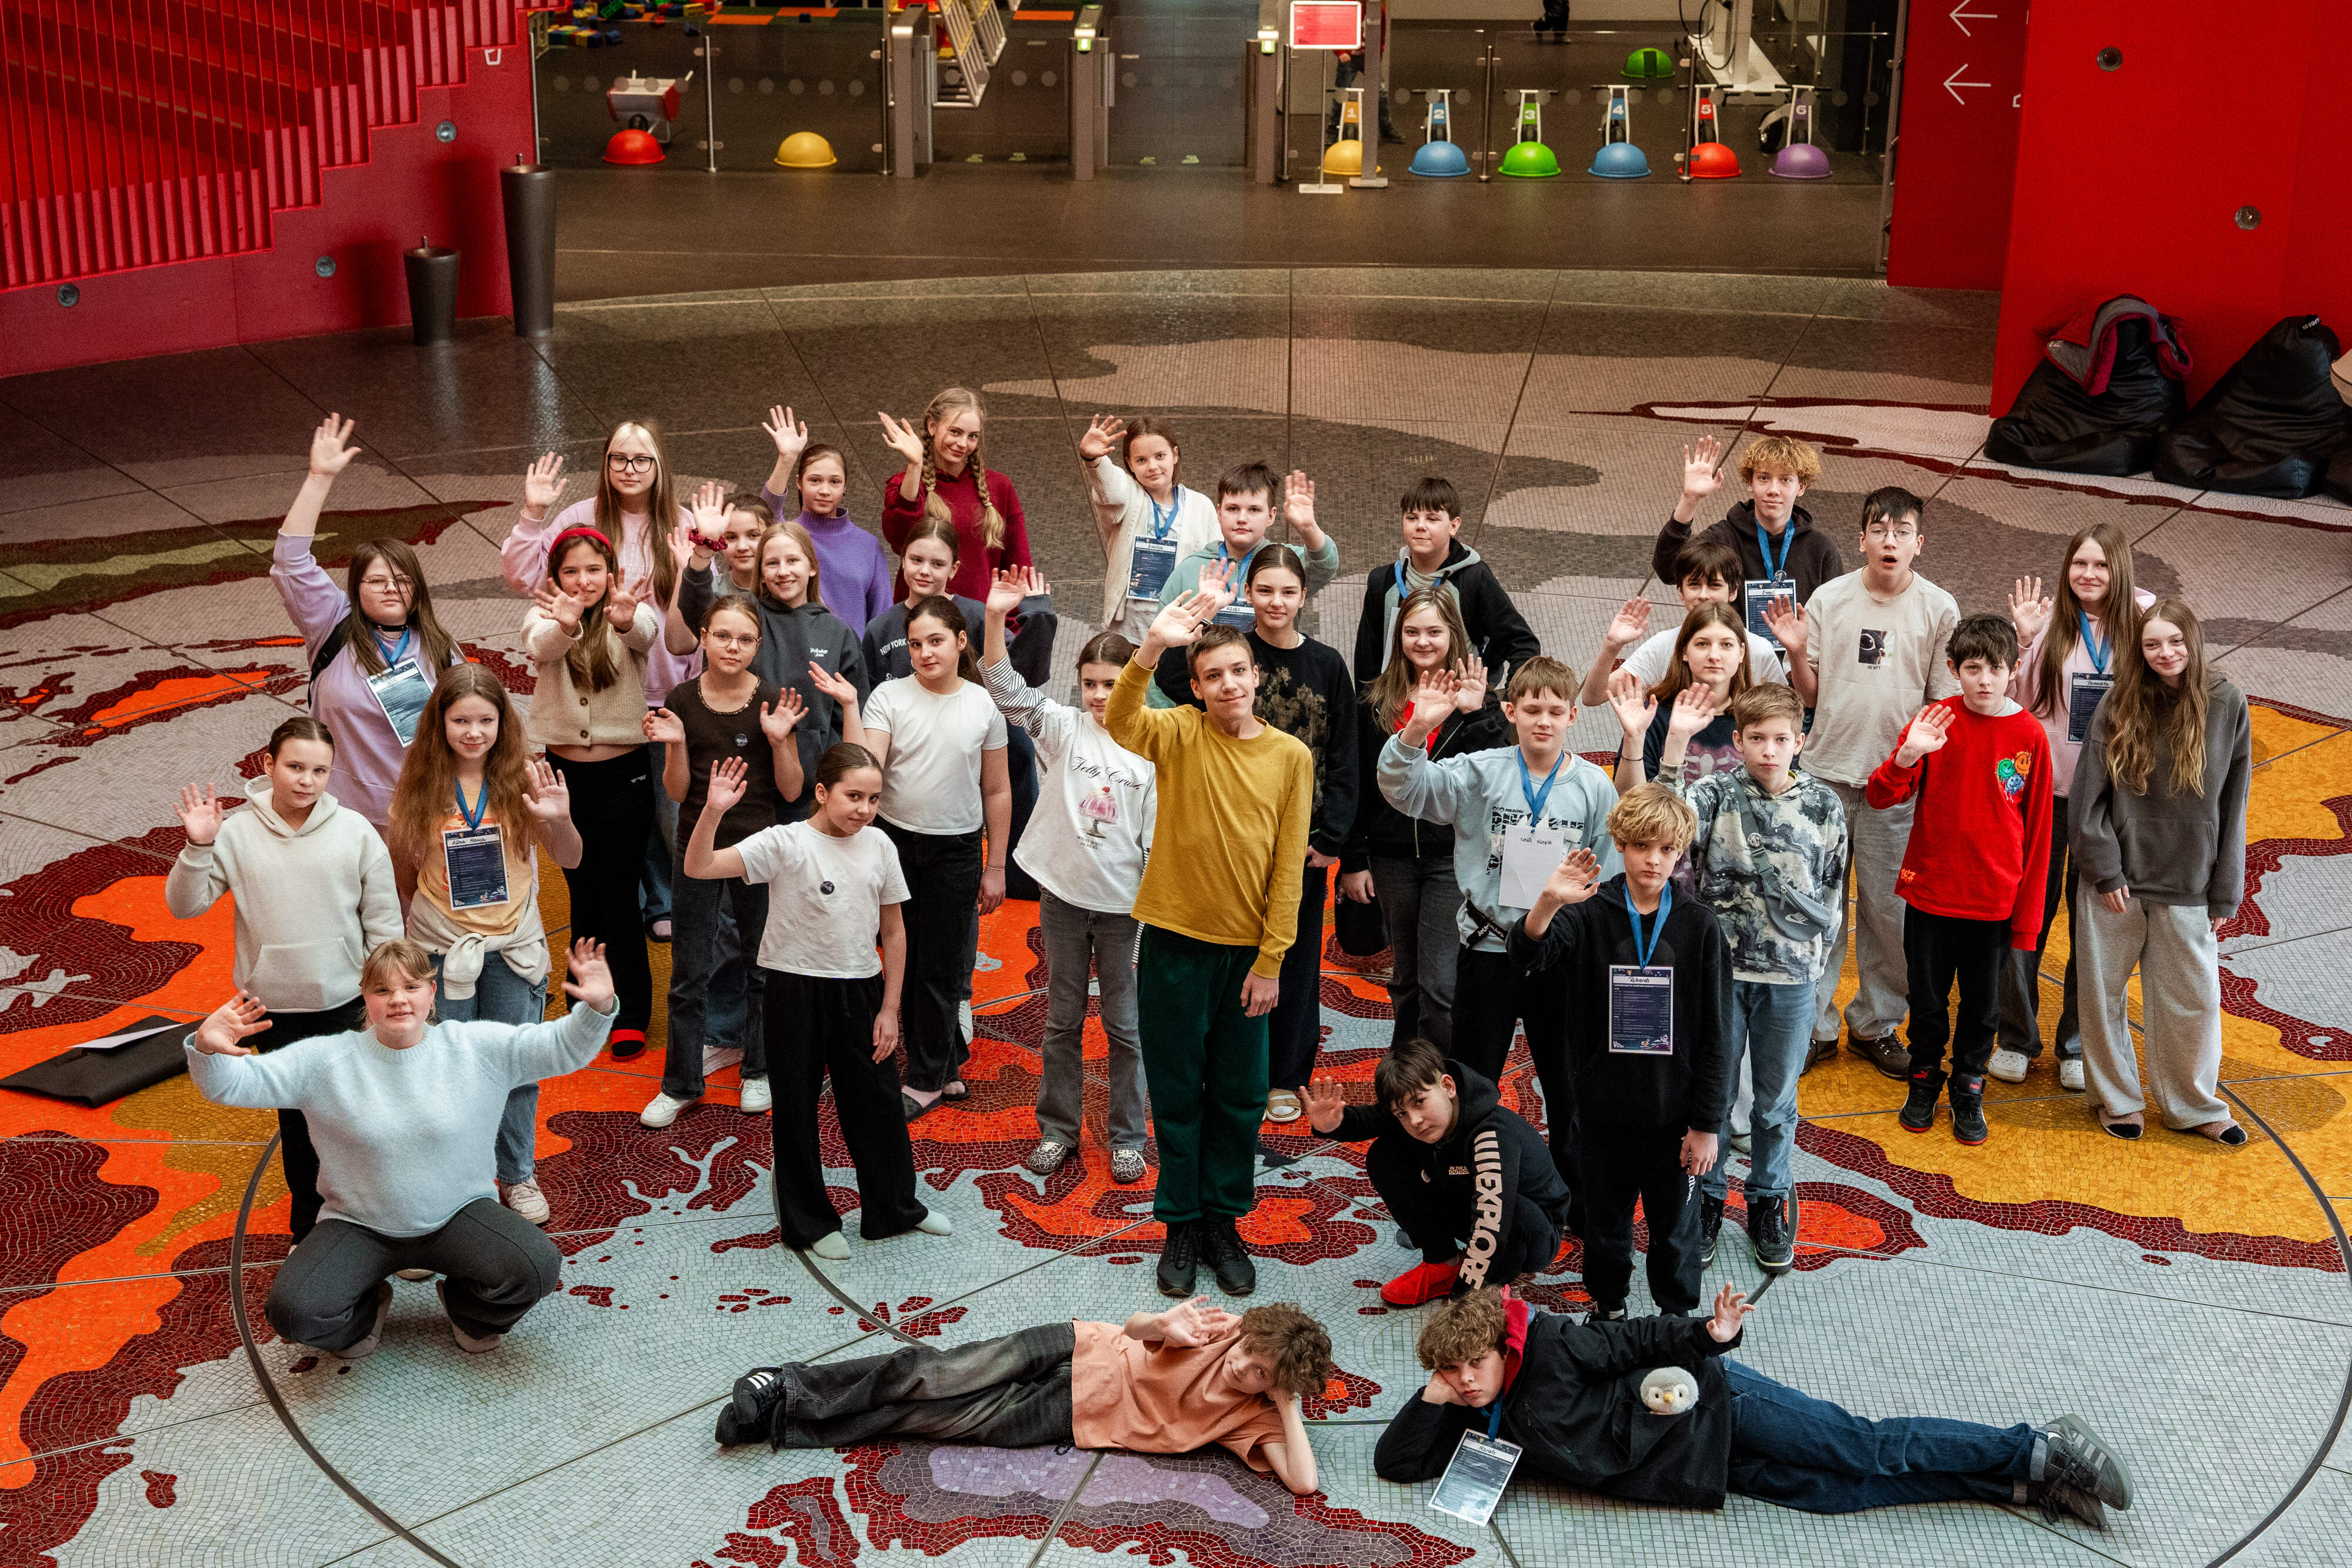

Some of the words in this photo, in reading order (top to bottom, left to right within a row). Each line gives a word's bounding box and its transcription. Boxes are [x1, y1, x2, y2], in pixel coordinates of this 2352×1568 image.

[1347, 108, 1356, 118] 1
[1434, 109, 1444, 119] 2
[1524, 109, 1535, 120] 3
[1612, 105, 1623, 115] 4
[1700, 104, 1712, 115] 5
[1796, 105, 1807, 115] 6
[880, 643, 891, 656] NEW
[890, 638, 906, 648] YORK
[1071, 756, 1102, 778] Jelly
[1105, 767, 1145, 790] Crush
[1459, 1171, 1503, 1290] EXPLORE
